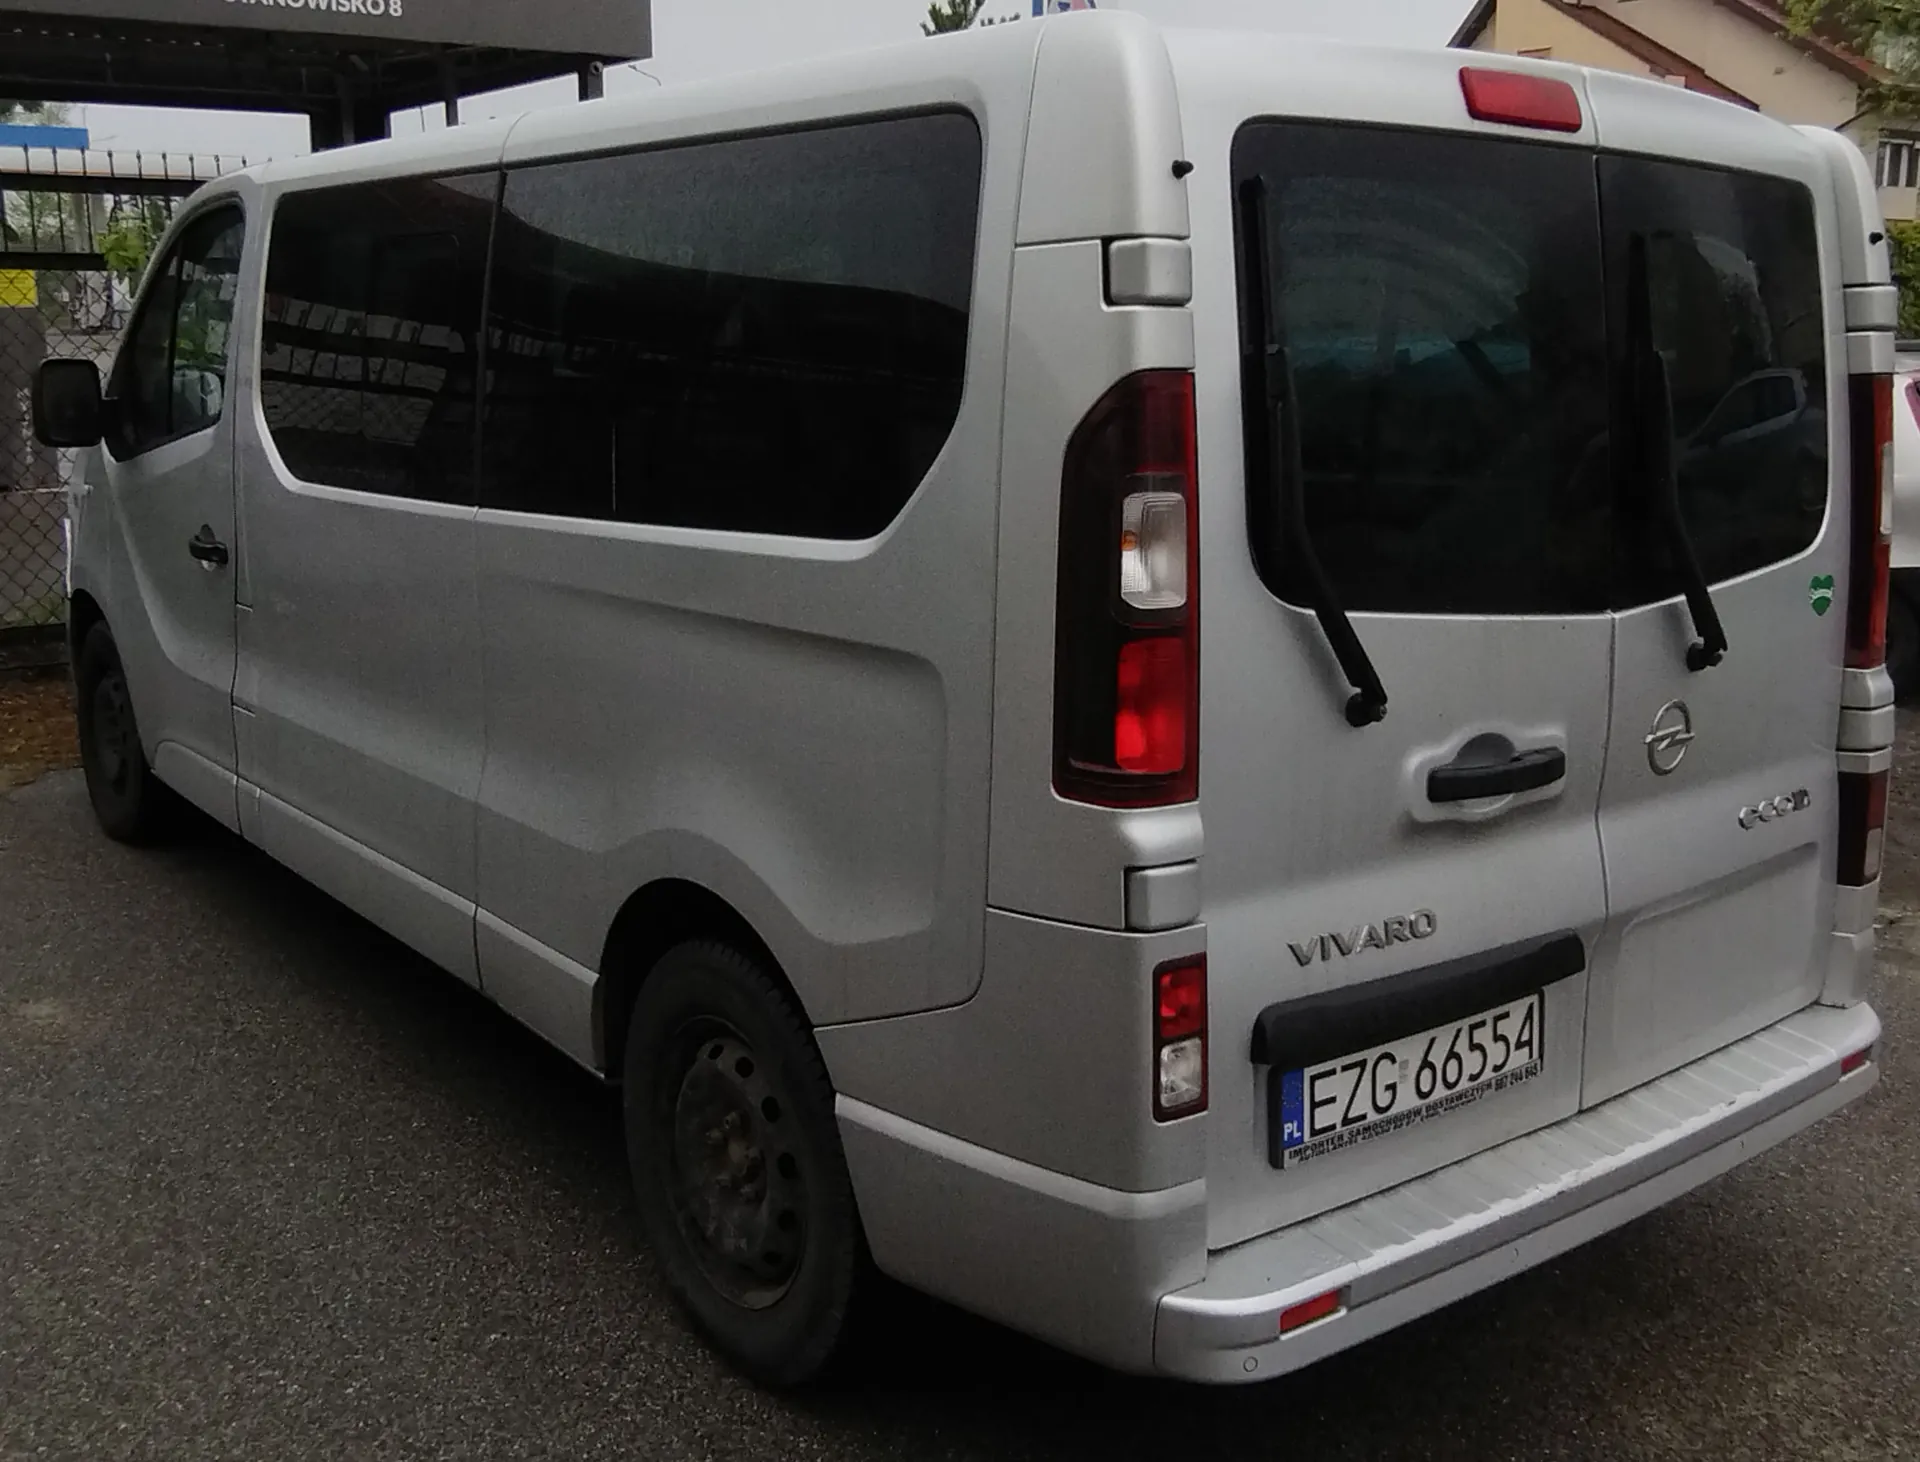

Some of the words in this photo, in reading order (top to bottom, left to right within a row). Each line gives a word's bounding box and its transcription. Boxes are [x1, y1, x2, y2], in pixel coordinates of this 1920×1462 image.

[389, 0, 403, 17] 8
[1287, 908, 1438, 967] VIVARO
[1309, 1051, 1398, 1139] EZG
[1414, 1002, 1534, 1100] 66554
[1284, 1119, 1302, 1142] PL
[1288, 1133, 1345, 1160] IMPORTER
[1425, 1080, 1492, 1114] DOSTAWCZYCH
